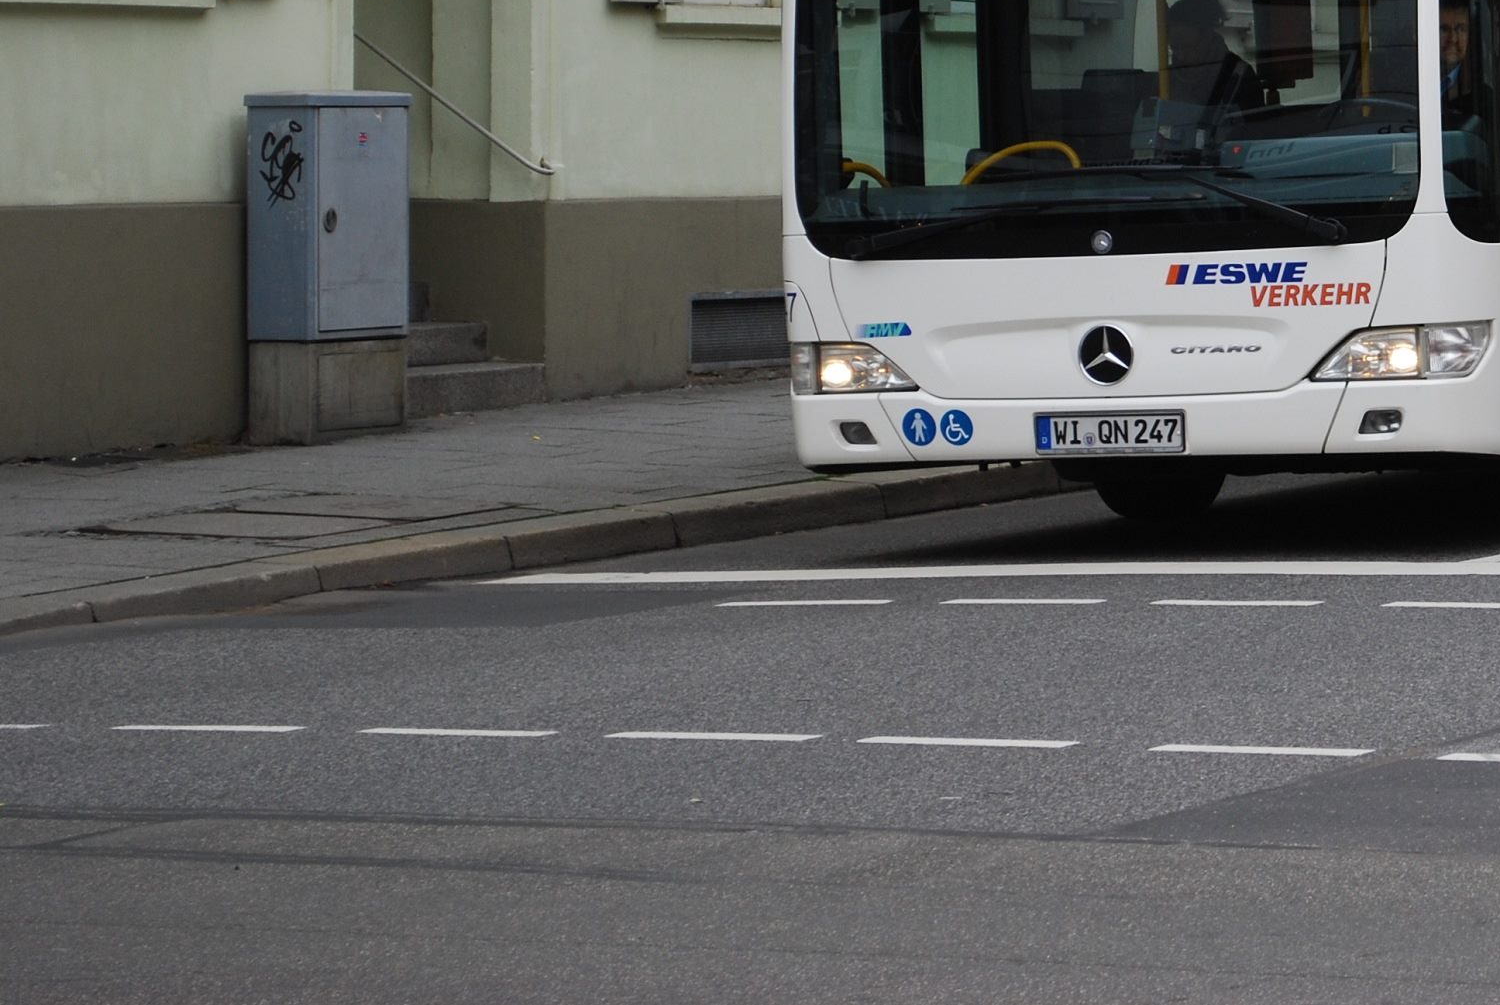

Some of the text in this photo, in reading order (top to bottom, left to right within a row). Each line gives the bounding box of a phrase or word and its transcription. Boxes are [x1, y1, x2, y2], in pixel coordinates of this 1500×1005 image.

[1192, 261, 1308, 285] ESWE
[1250, 282, 1372, 308] VERKEHR
[1170, 344, 1263, 355] CITARO
[1053, 420, 1082, 445] WI
[1098, 419, 1129, 444] QN
[1134, 418, 1178, 444] 247
